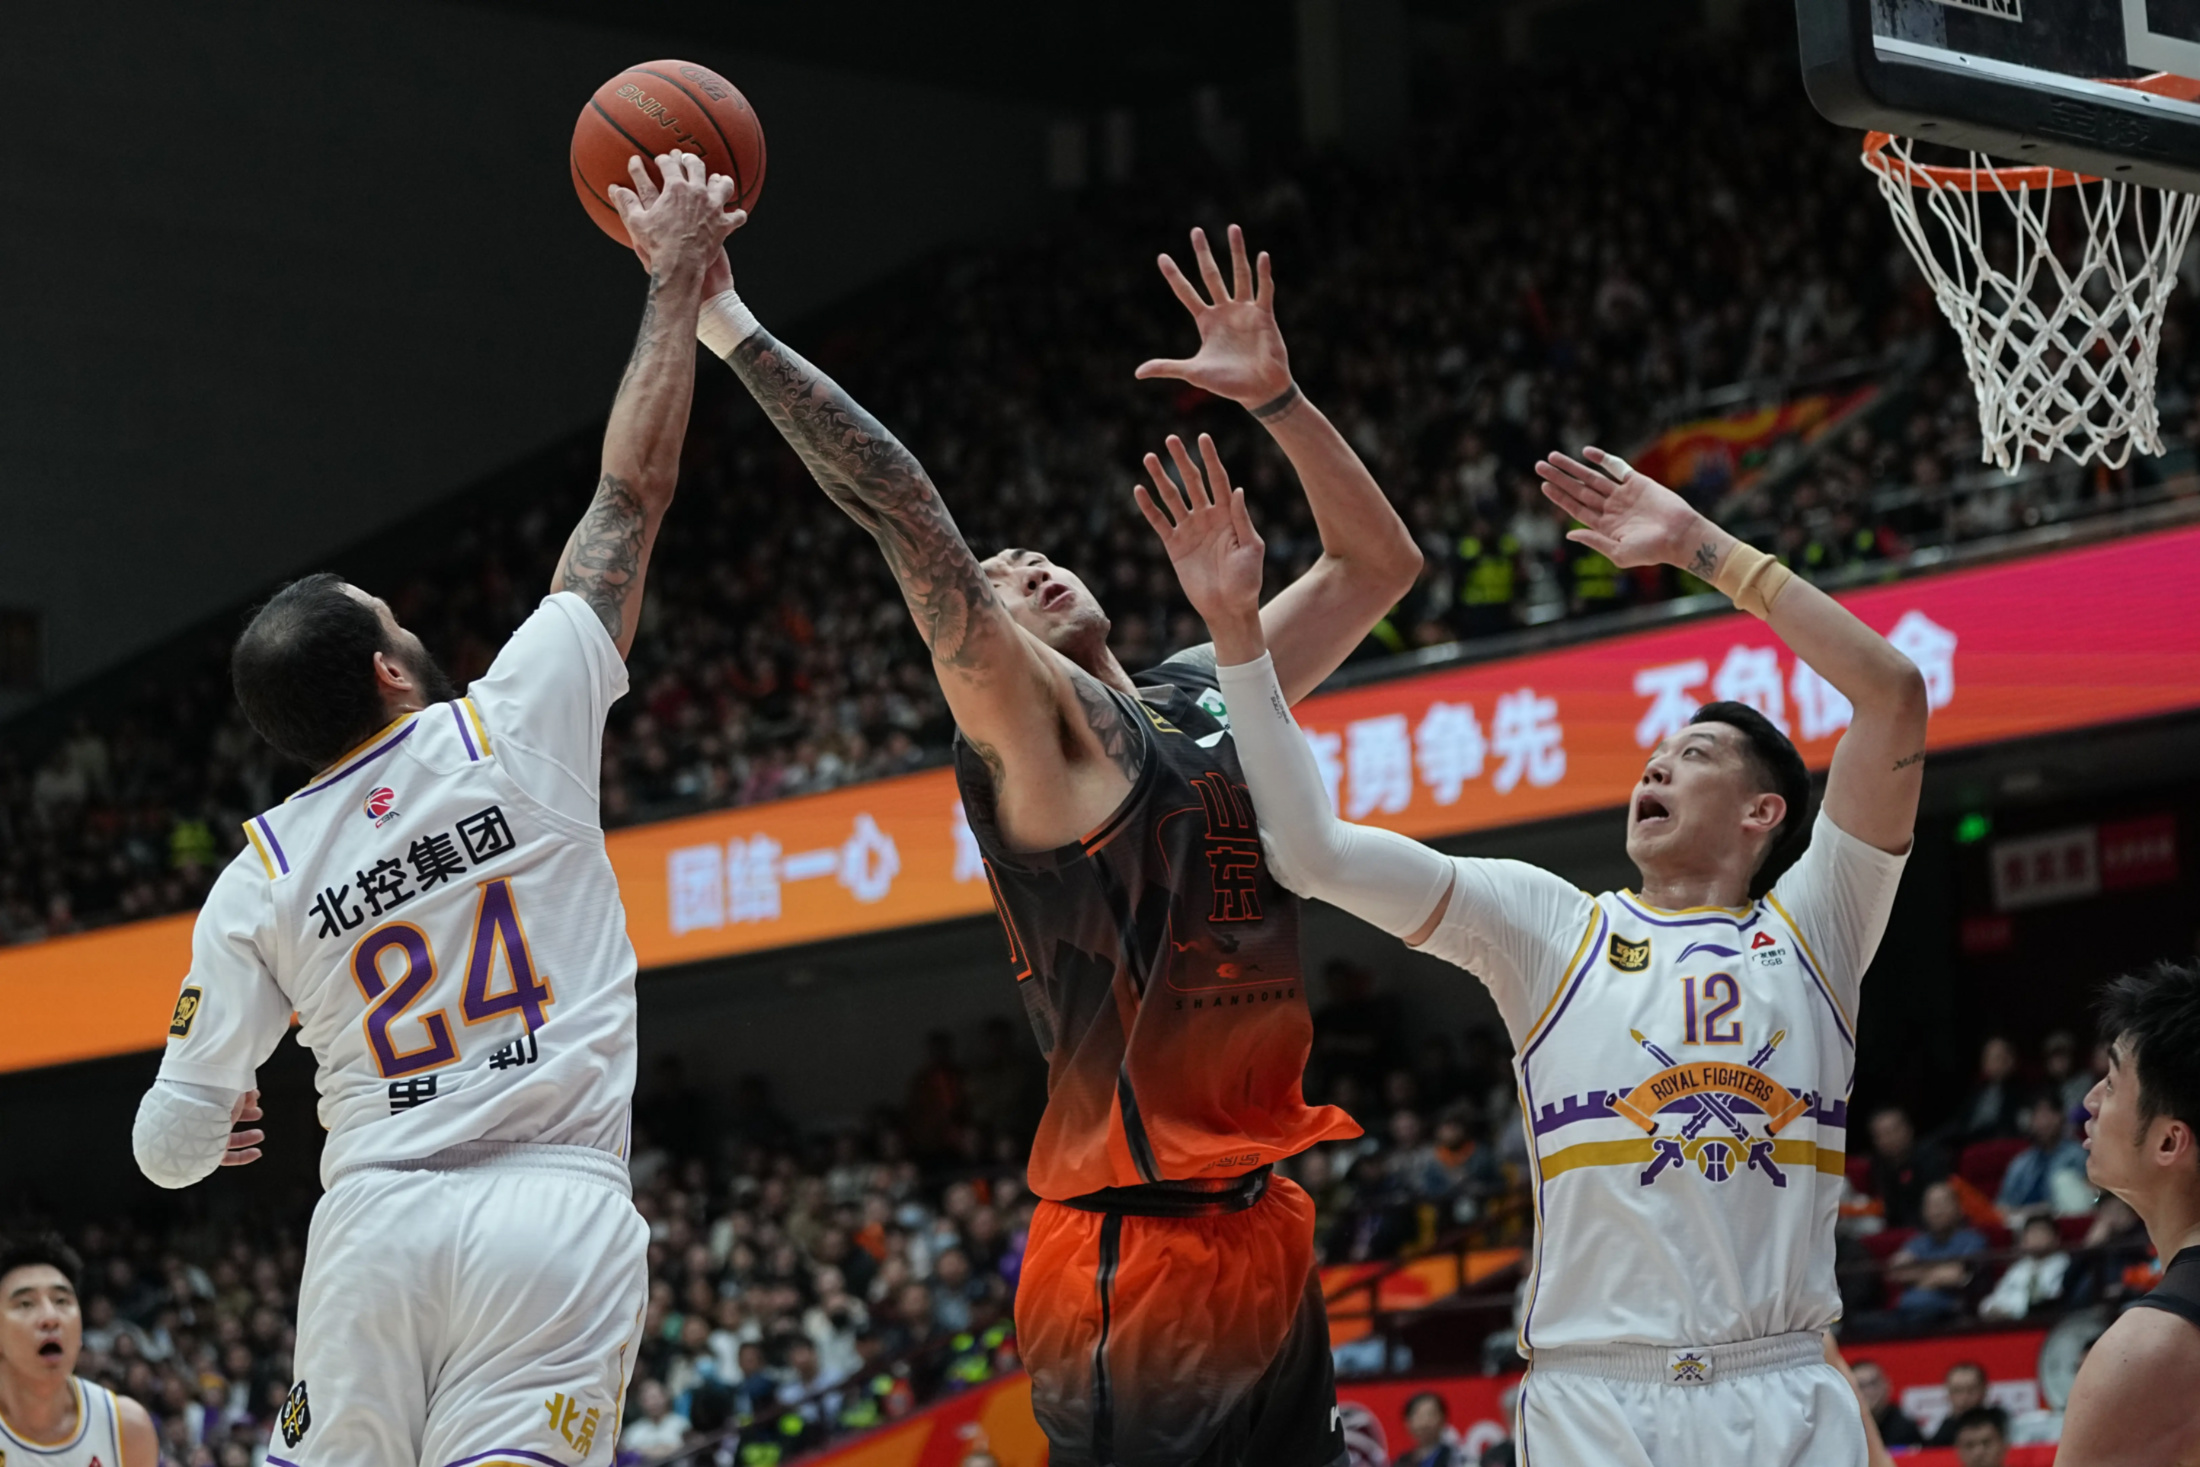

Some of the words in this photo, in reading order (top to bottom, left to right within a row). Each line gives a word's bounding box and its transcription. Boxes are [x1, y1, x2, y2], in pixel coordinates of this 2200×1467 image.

[615, 83, 709, 159] LI-NING
[375, 811, 400, 829] CBA
[1190, 771, 1263, 921] 山东
[308, 805, 516, 940] 北控集团
[666, 812, 901, 935] 团结一心
[349, 875, 556, 1079] 24
[1175, 987, 1295, 1011] SHANDONG
[1761, 957, 1783, 967] CGB
[1679, 970, 1744, 1046] 12
[1650, 1069, 1700, 1102] ROYAL
[1703, 1067, 1774, 1102] FIGHTERS
[544, 1391, 601, 1459] 北京
